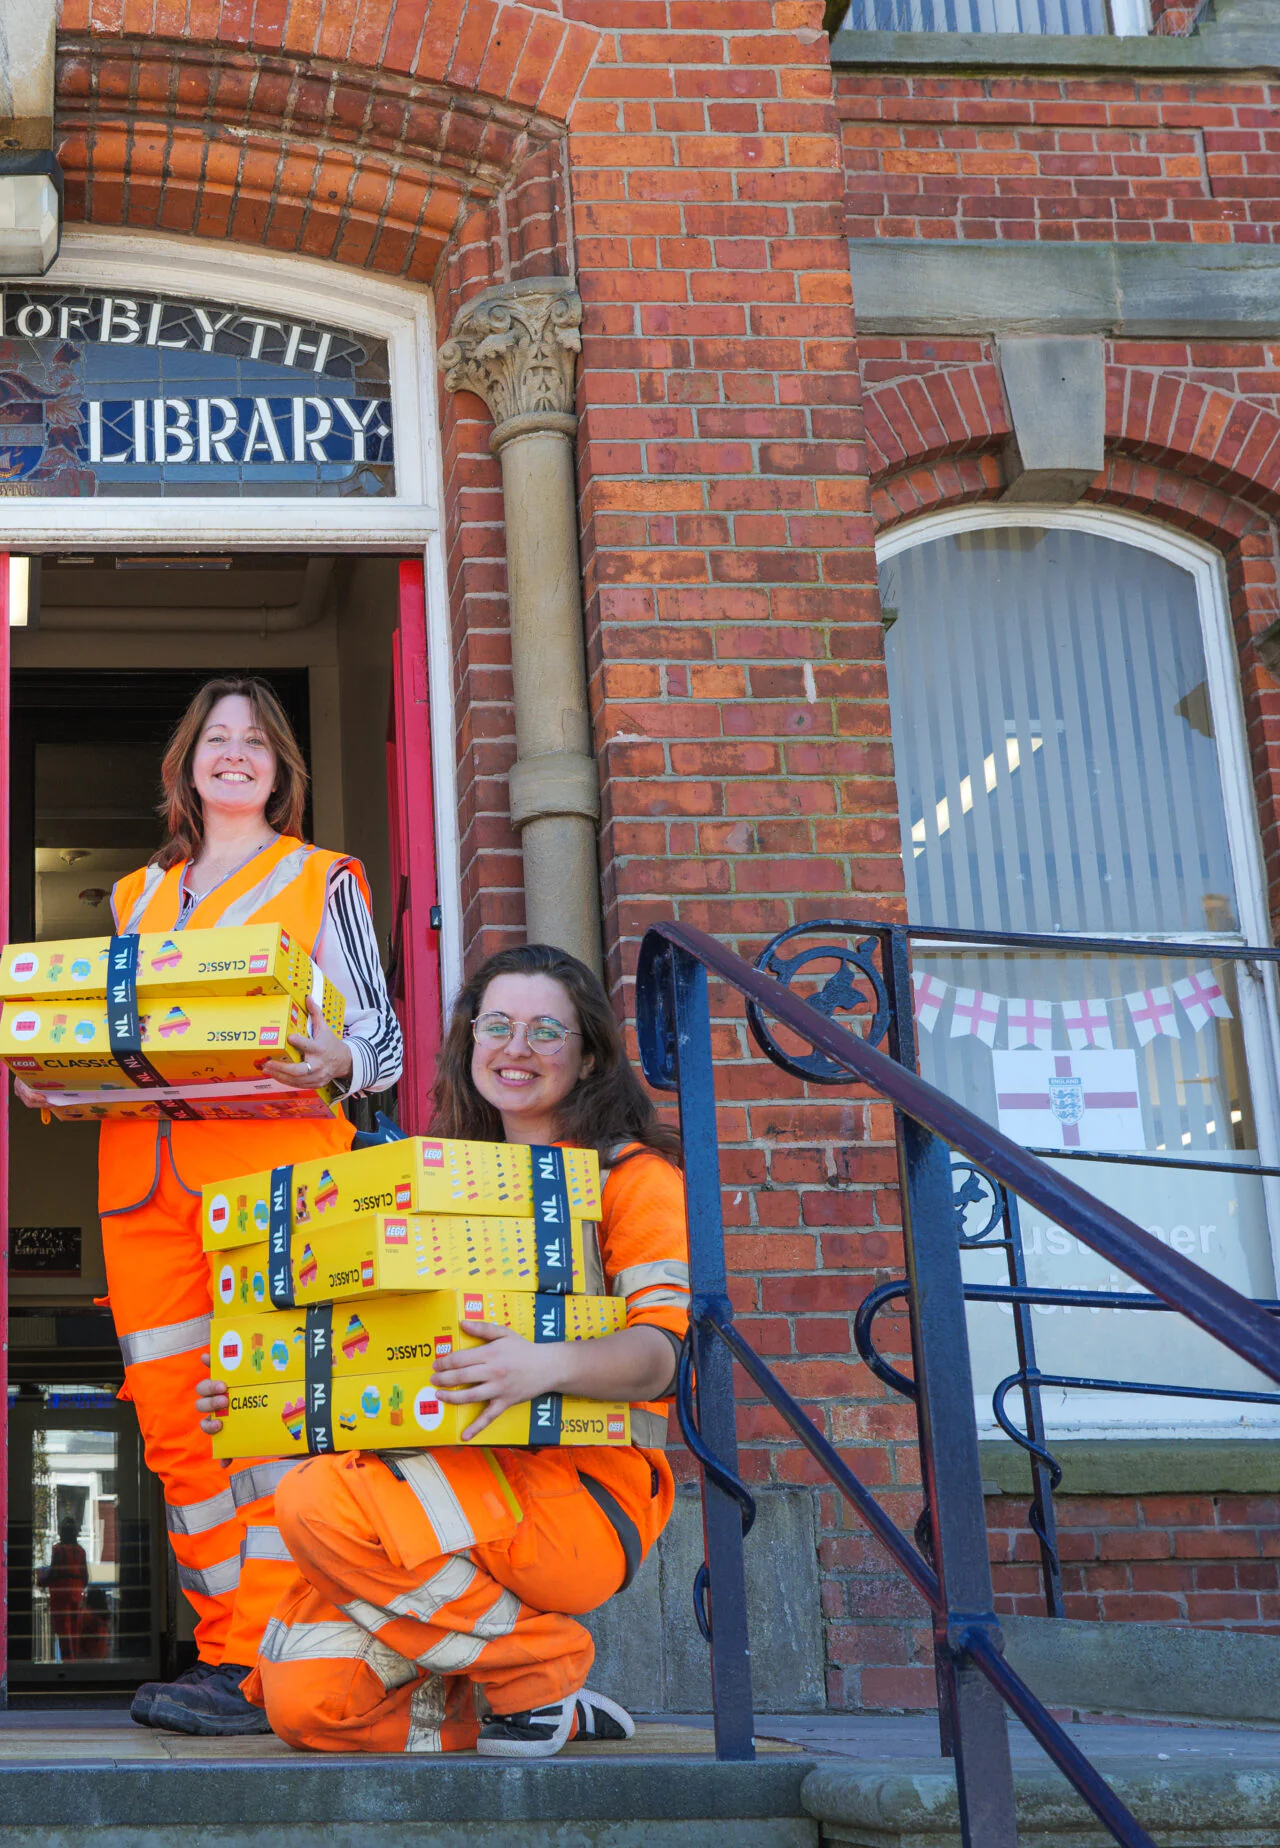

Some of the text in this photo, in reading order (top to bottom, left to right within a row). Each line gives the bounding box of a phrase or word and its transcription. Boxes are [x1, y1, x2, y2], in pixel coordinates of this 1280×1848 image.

[16, 305, 91, 340] OF
[101, 296, 335, 373] BLYTH
[88, 397, 380, 464] LIBRARY
[113, 947, 128, 970] NL
[112, 979, 128, 1003] NL
[114, 1013, 131, 1038] NL
[423, 1149, 443, 1160] LEGO
[537, 1151, 556, 1180] NL
[273, 1182, 284, 1212] NL
[541, 1193, 560, 1223] NL
[273, 1223, 284, 1253] NL
[386, 1225, 406, 1238] LEGO
[543, 1237, 563, 1267] NL
[273, 1266, 286, 1296] NL
[465, 1301, 483, 1312] LEGO
[541, 1307, 556, 1337] NL
[312, 1328, 326, 1358] NL
[231, 1394, 269, 1411] CLASSIC
[312, 1383, 326, 1412] NL
[536, 1396, 552, 1427] NL
